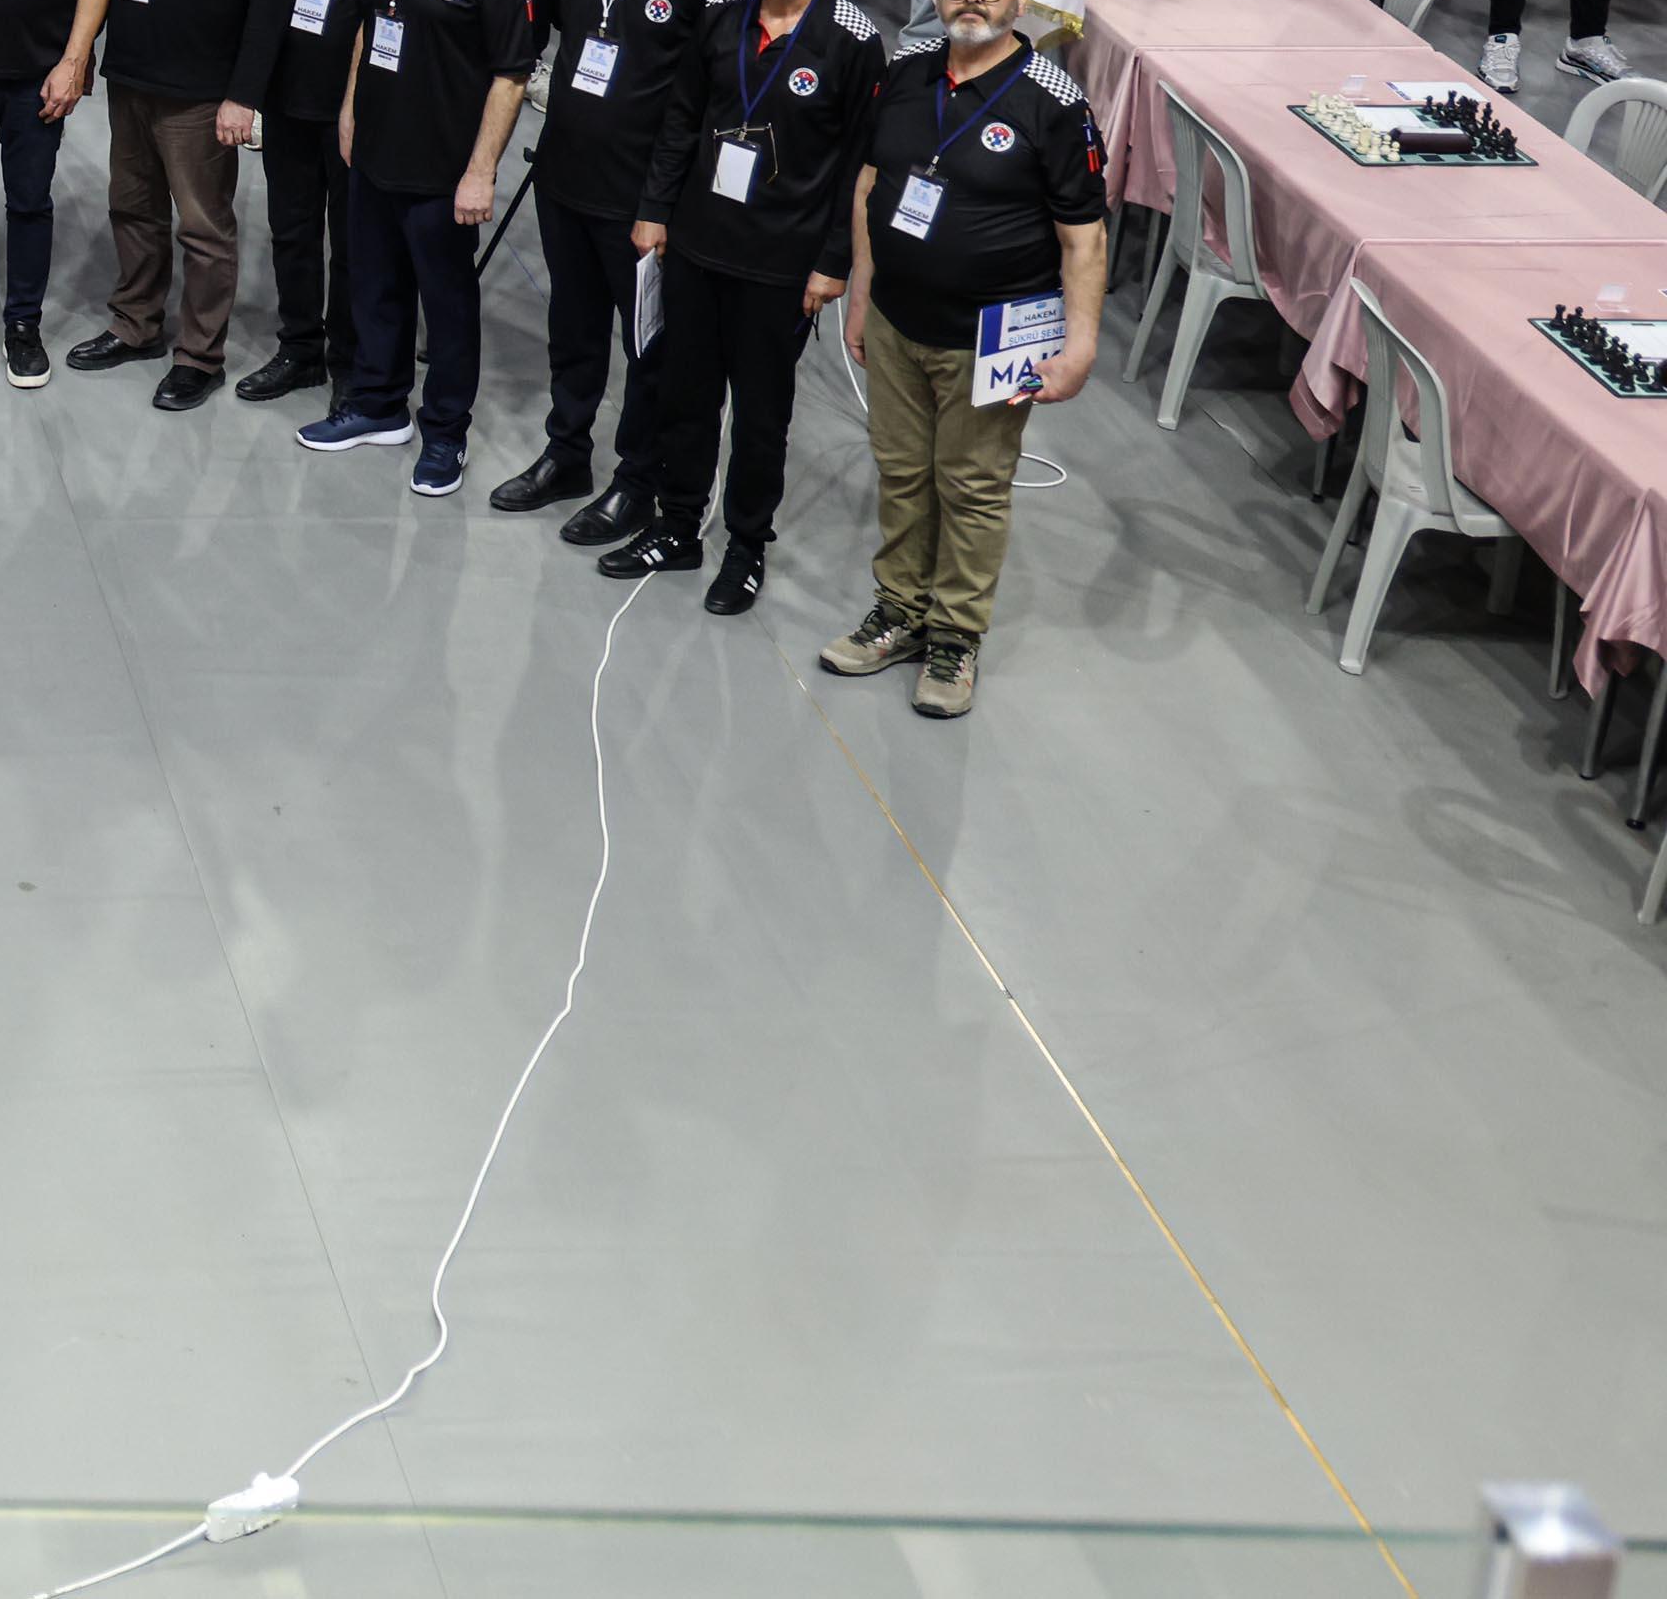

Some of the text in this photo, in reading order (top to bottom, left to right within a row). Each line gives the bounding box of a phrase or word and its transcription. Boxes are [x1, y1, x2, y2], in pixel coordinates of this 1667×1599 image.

[297, 6, 322, 18] HAKEM
[375, 43, 398, 55] HAKEM
[580, 66, 606, 78] HAKEM
[902, 204, 929, 220] HAKEM
[1024, 310, 1057, 322] HAKEM
[1008, 329, 1039, 347] ŞÜKRÜ
